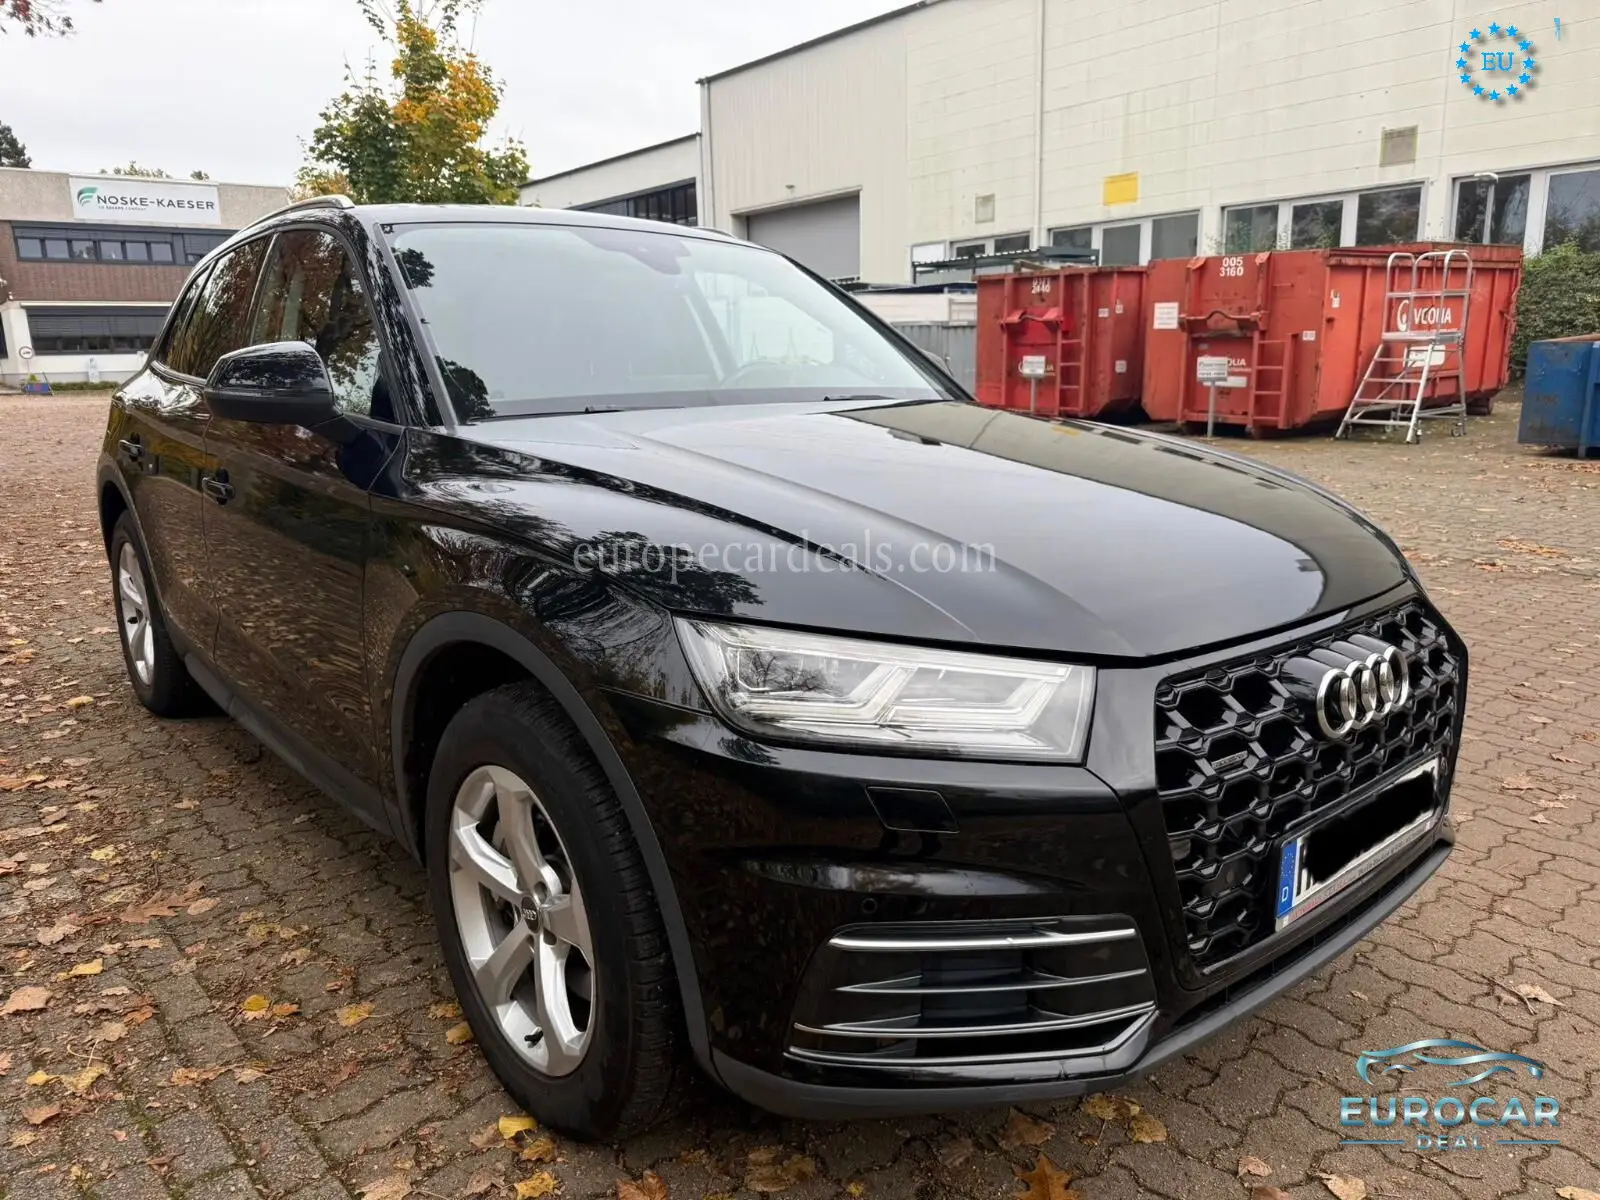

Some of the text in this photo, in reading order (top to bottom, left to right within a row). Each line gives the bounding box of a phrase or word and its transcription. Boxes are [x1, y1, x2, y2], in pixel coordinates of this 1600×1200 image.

[96, 195, 215, 210] NOSKE-KAESER
[1222, 256, 1244, 267] 005
[1219, 266, 1244, 277] 3160
[1281, 886, 1289, 903] D
